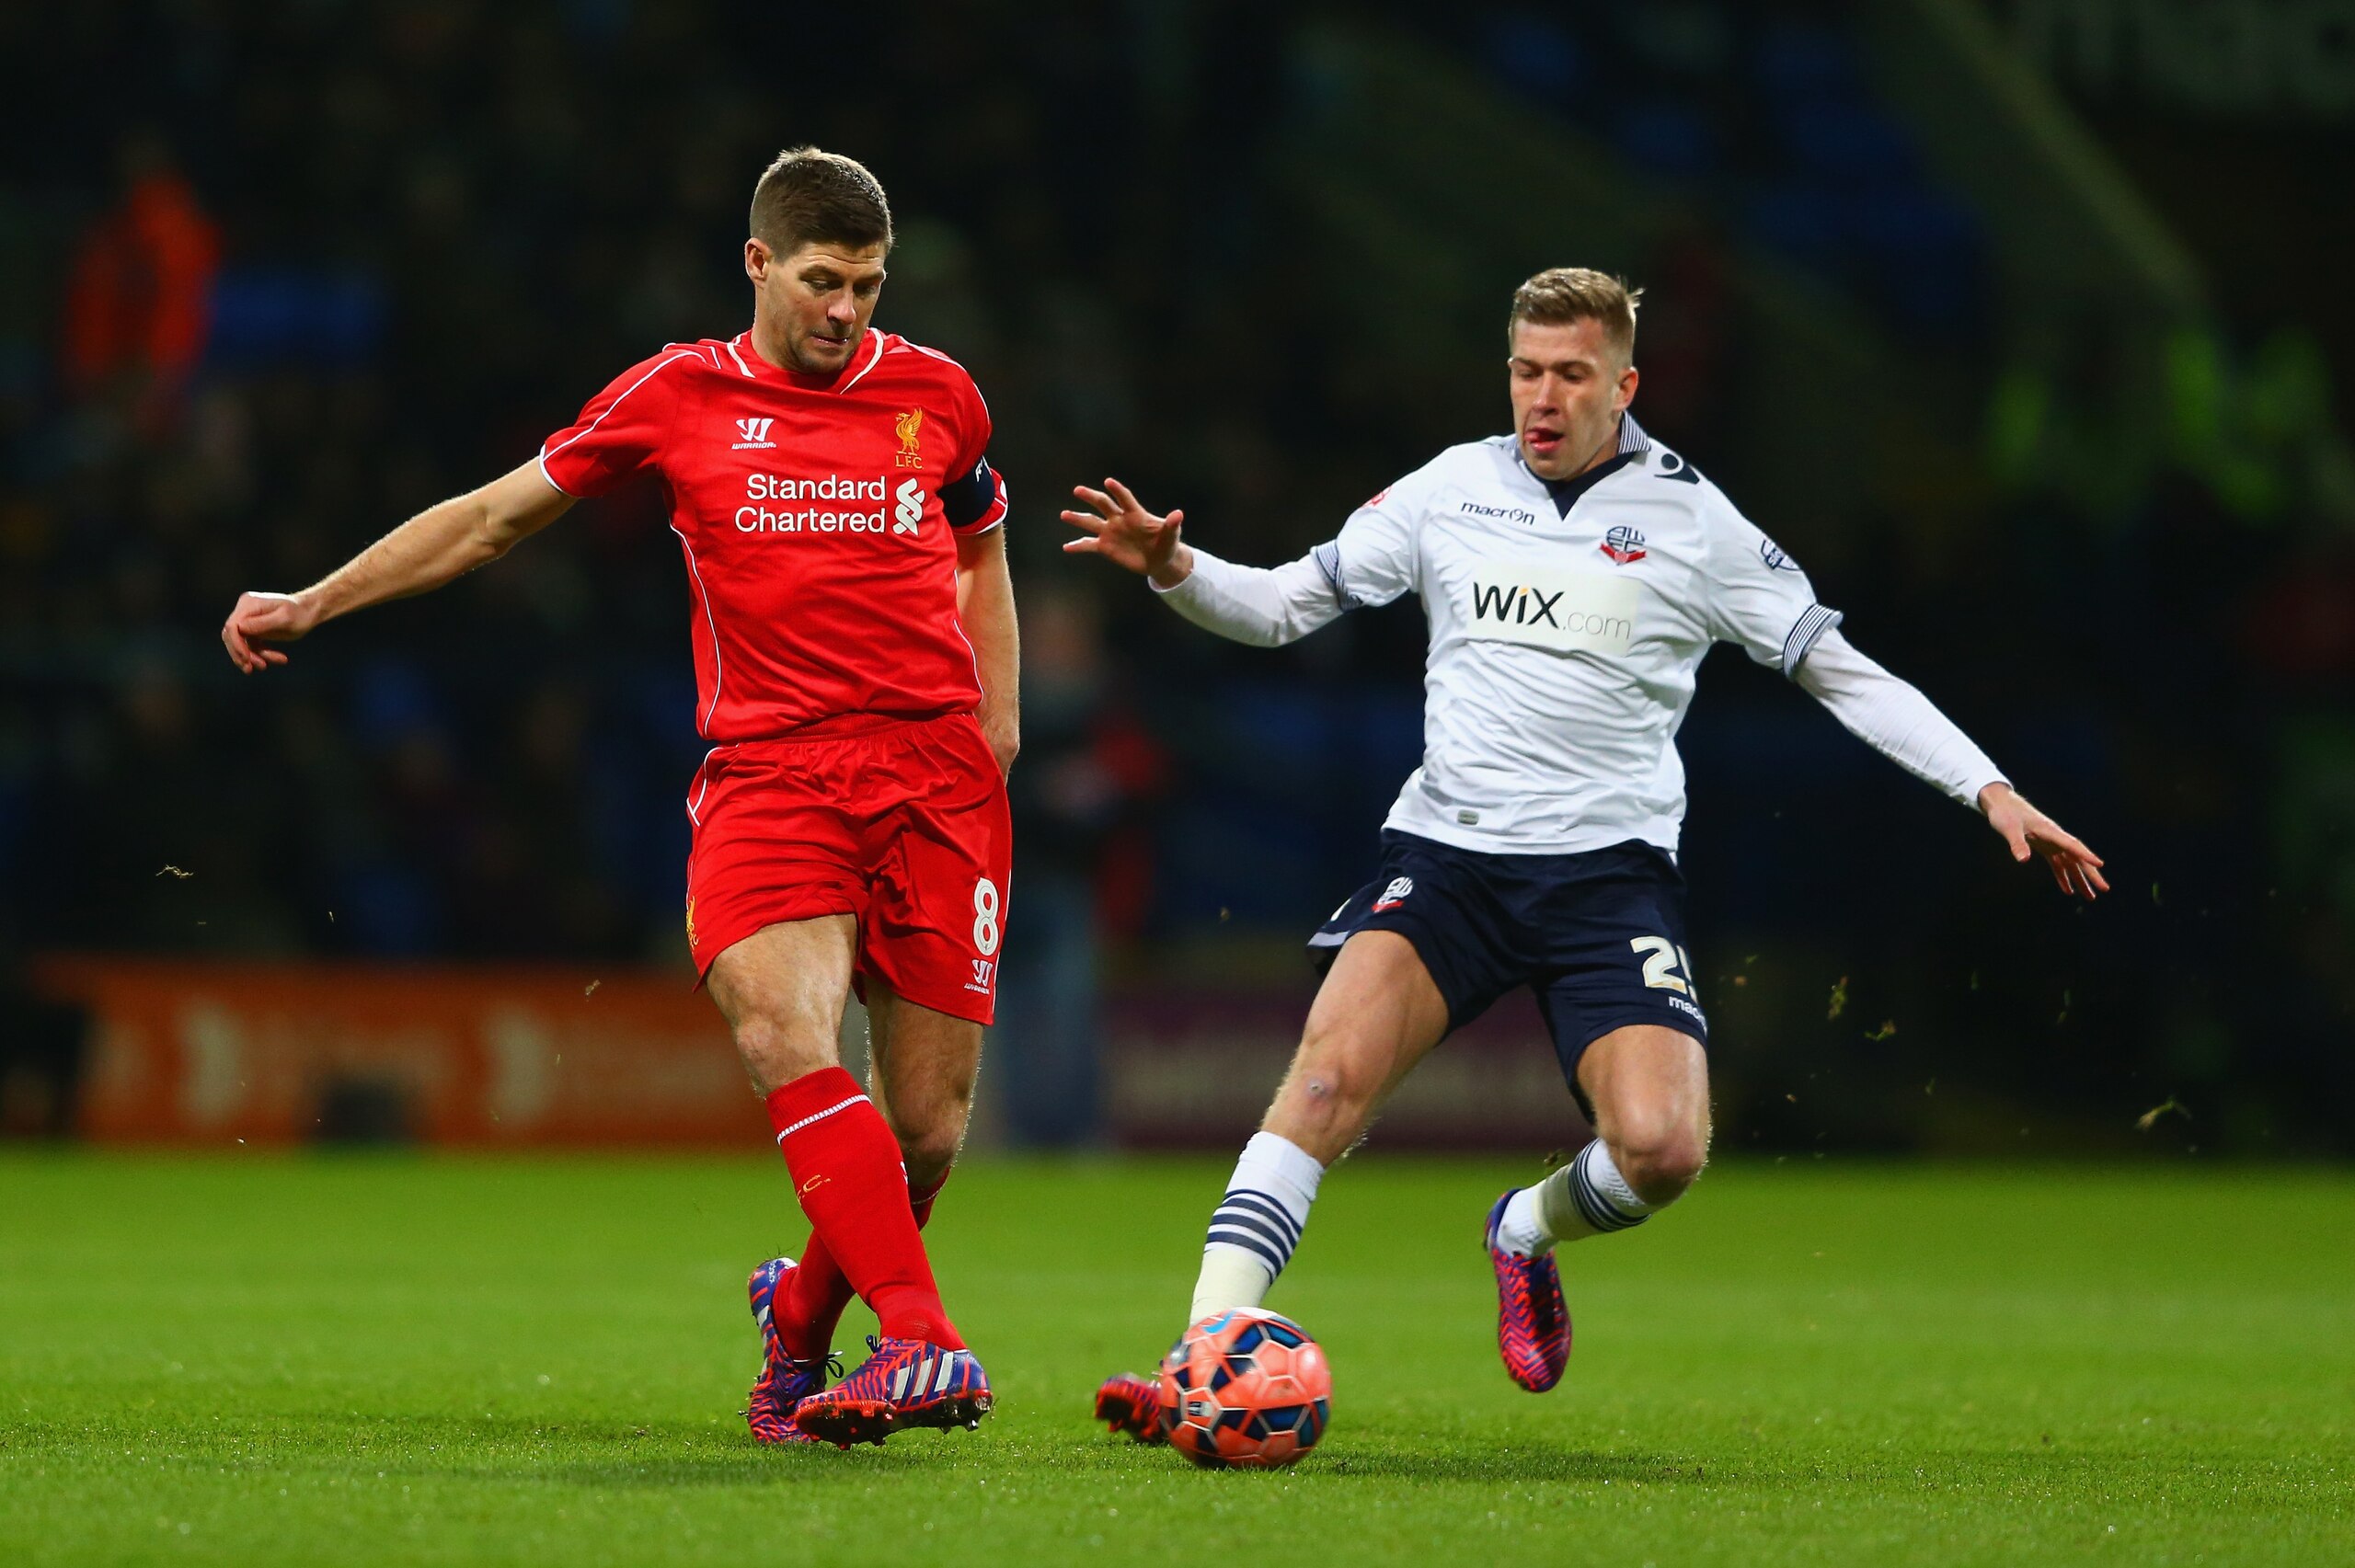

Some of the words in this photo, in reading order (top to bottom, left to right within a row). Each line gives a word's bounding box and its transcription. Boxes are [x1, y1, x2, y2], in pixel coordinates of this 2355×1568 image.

[895, 455, 923, 469] LFC
[746, 474, 886, 500] Standard
[735, 506, 886, 533] Chartered
[1461, 502, 1535, 526] macron
[973, 876, 999, 956] 8
